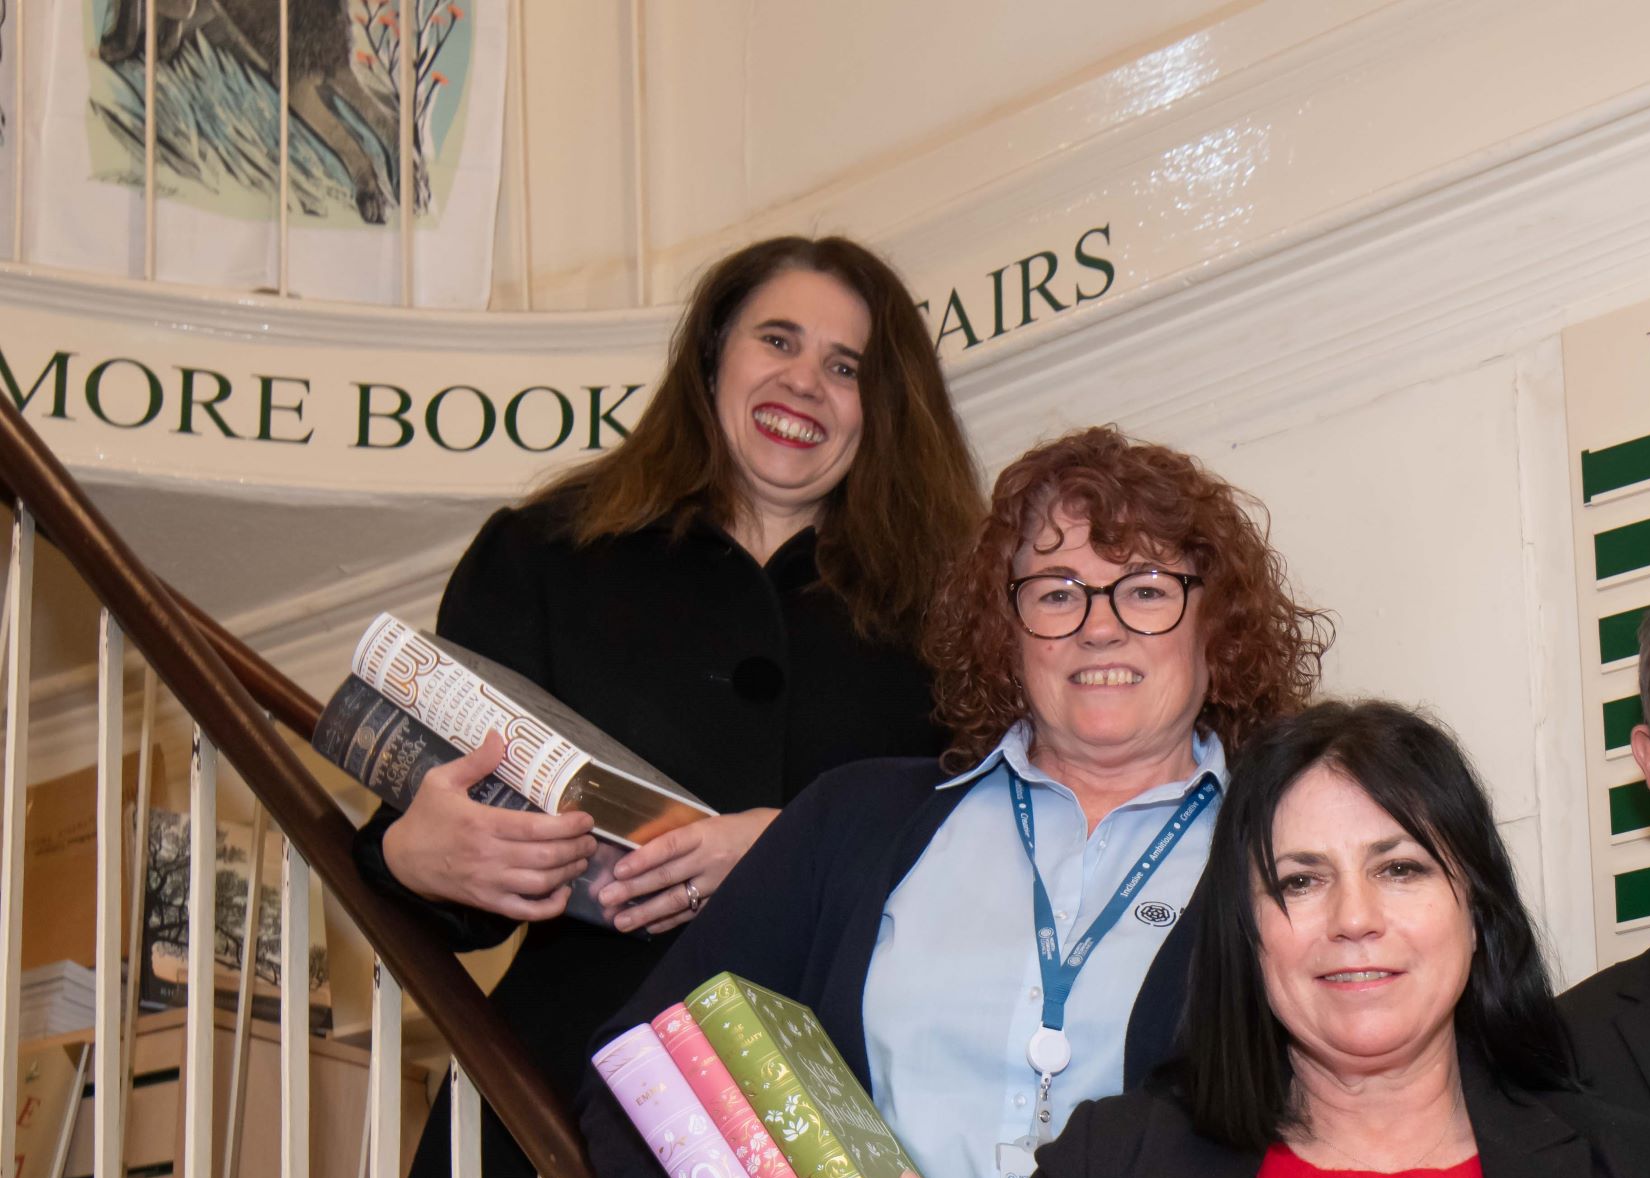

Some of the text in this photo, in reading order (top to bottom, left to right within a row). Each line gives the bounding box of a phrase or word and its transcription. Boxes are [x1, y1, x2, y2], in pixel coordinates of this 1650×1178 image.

[916, 222, 1115, 351] AIRS
[0, 350, 314, 445] MORE
[348, 381, 646, 452] BOOK
[1120, 800, 1199, 898] Inclusive Ambitious Creative
